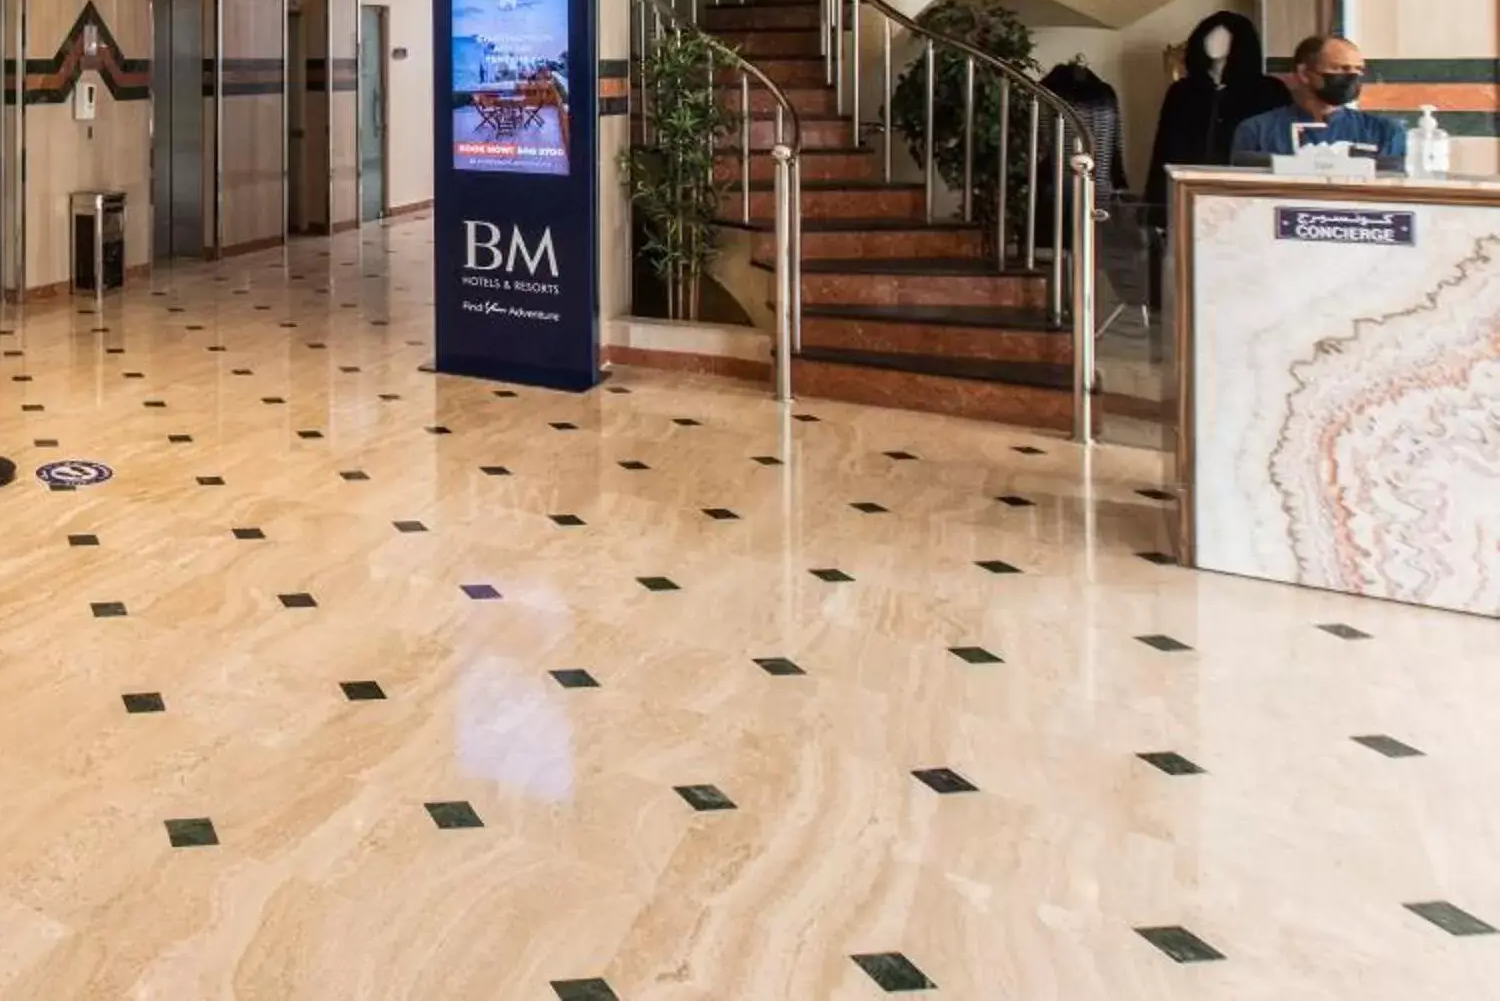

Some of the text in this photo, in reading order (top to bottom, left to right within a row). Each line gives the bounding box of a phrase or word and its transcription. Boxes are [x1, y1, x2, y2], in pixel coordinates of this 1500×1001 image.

[1295, 225, 1395, 241] CONCIERGE
[463, 220, 559, 277] BM
[462, 276, 560, 295] HOTELS & RESORTS
[462, 300, 483, 312] Find
[508, 305, 560, 322] Adventure
